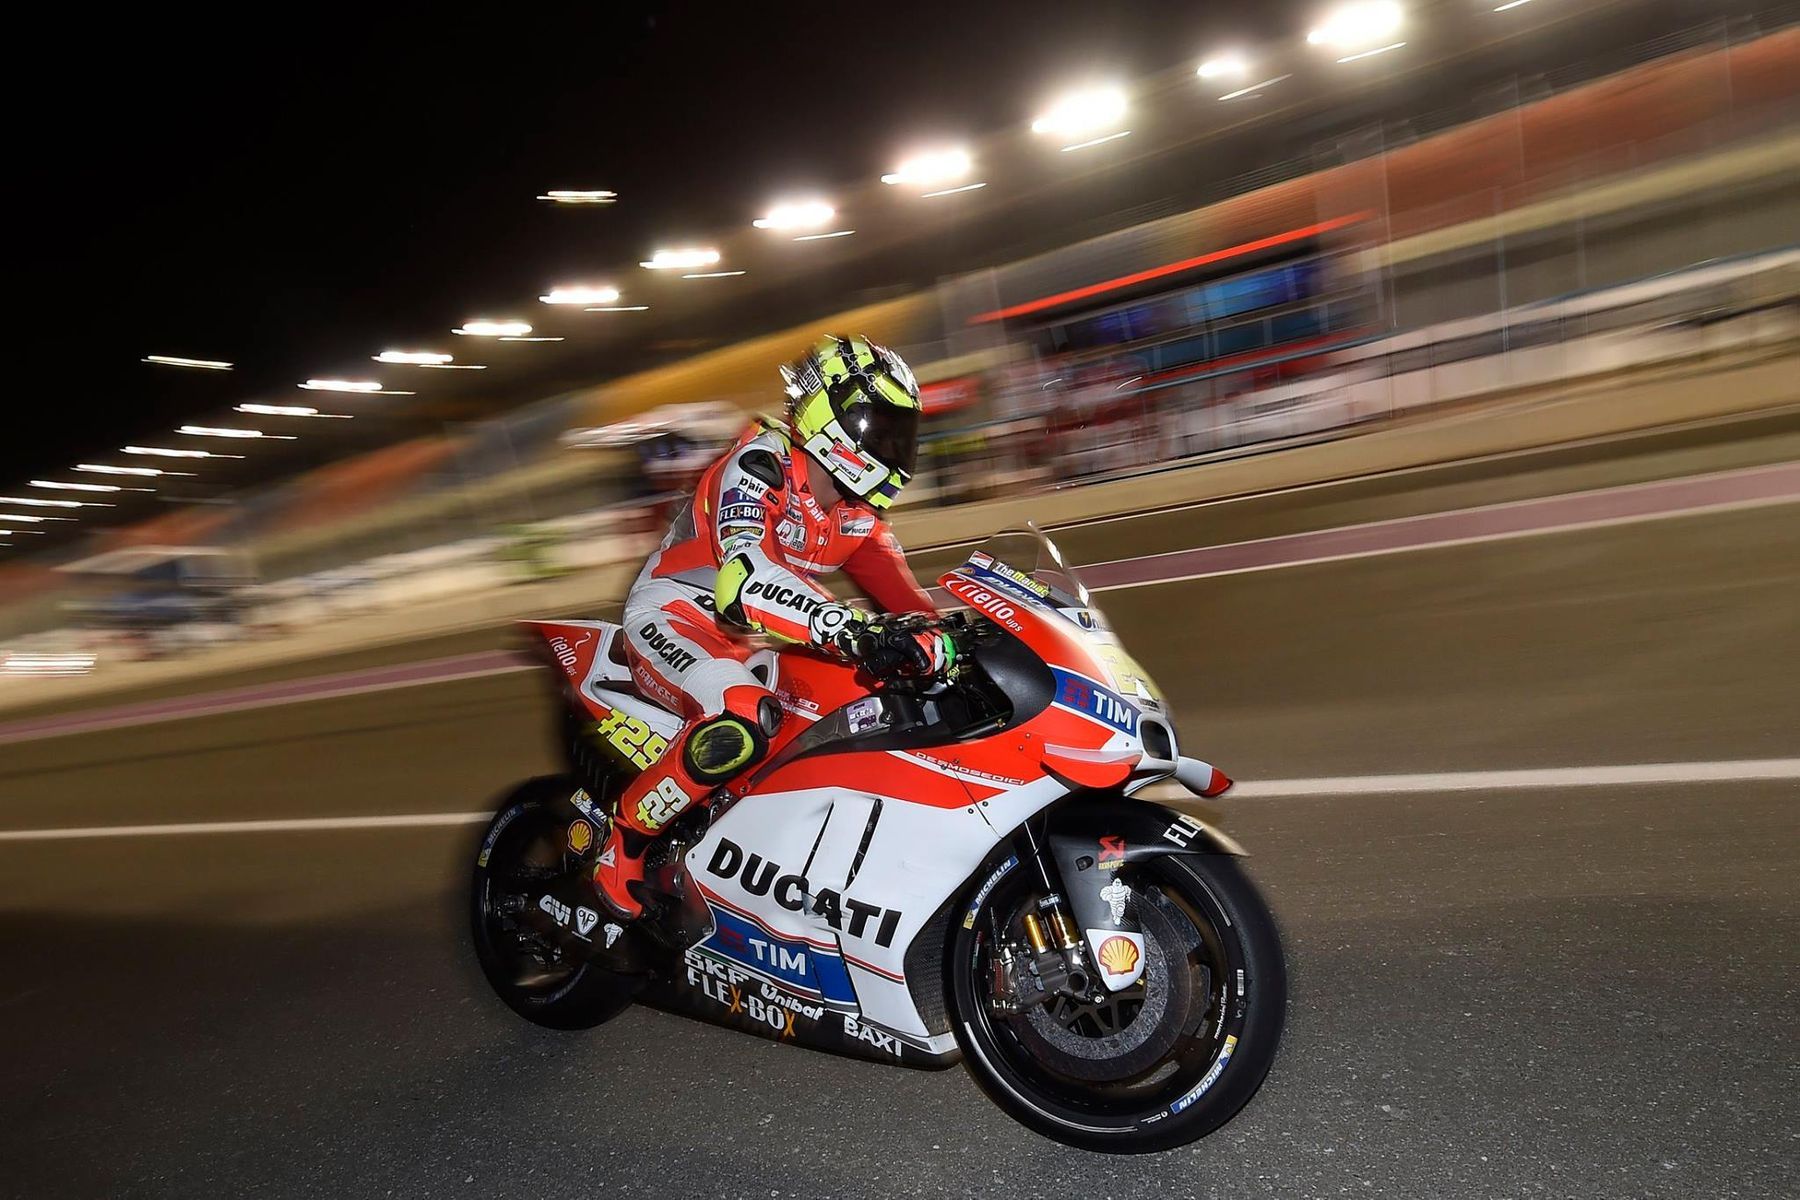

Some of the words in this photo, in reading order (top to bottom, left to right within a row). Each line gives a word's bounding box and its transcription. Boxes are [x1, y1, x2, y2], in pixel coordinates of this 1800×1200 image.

[838, 463, 857, 479] DUCATI
[745, 581, 821, 613] DUCAT
[958, 584, 1015, 620] riello
[1005, 618, 1023, 632] ups
[549, 636, 577, 667] riello
[639, 622, 698, 673] DUCATI
[1093, 689, 1132, 730] TIM
[487, 808, 517, 844] MICHELIN
[706, 837, 902, 949] DUCATI
[975, 859, 1012, 905] MICHELIN
[539, 894, 572, 926] GIVI
[684, 950, 749, 985] SKF
[748, 938, 806, 976] TIM
[687, 965, 796, 1038] FLEX-BOX
[760, 983, 824, 1021] Unibat
[844, 1016, 902, 1057] BAXI
[1178, 1062, 1224, 1110] MICHELIN
